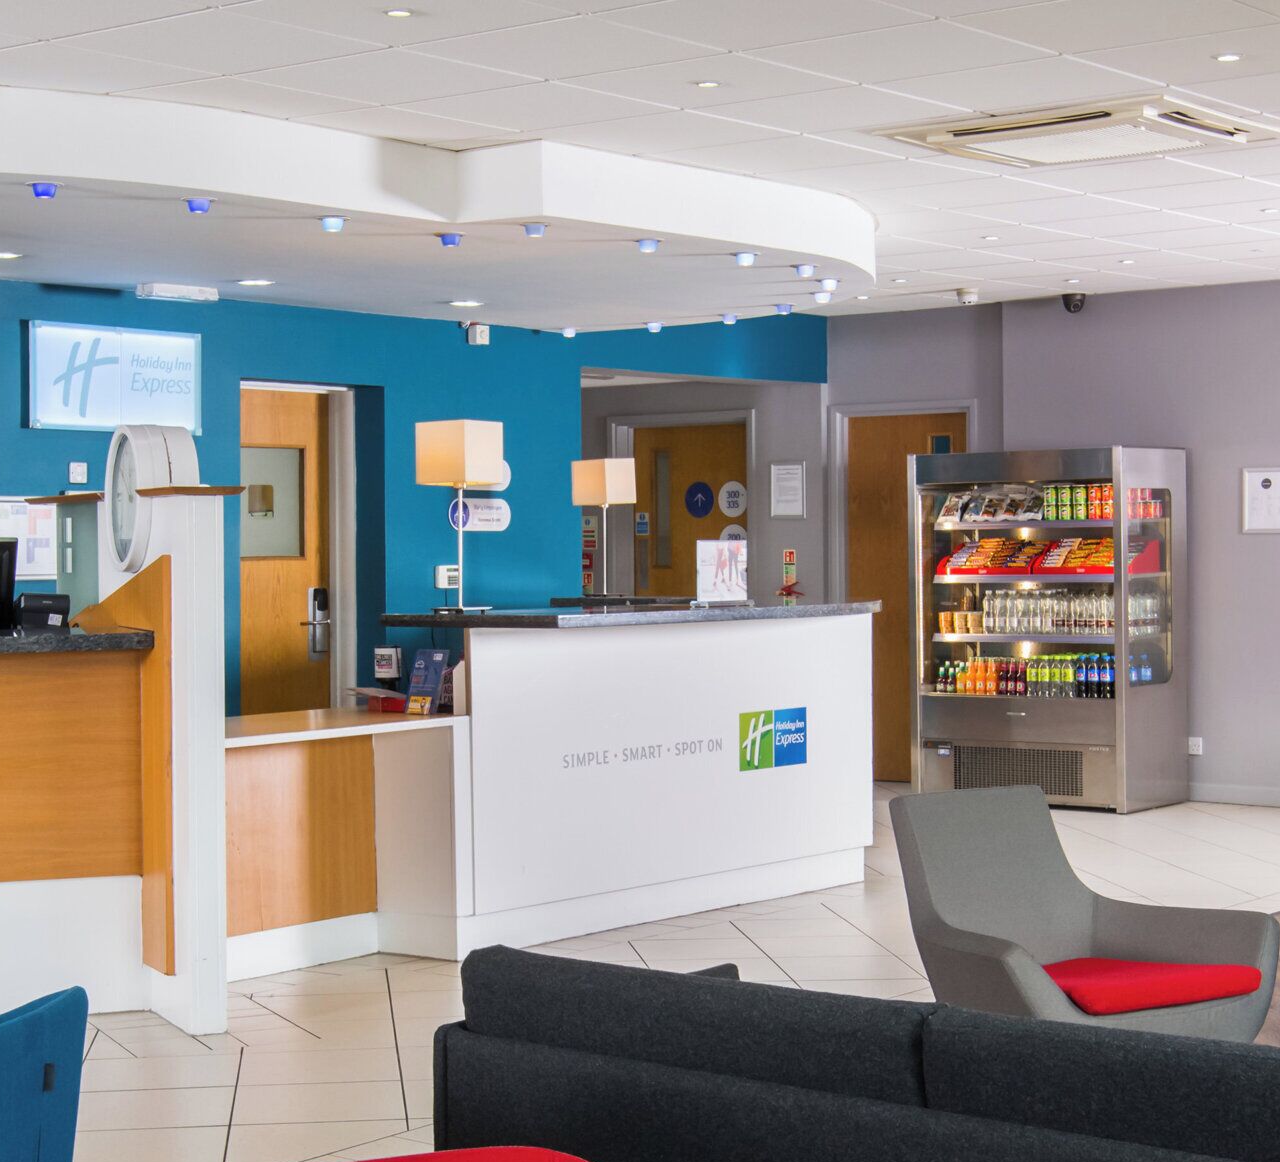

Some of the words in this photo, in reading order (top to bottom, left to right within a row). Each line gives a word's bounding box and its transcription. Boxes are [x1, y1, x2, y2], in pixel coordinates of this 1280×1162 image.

[130, 353, 174, 374] Holiday
[175, 357, 192, 371] Inn
[130, 372, 192, 398] Express
[726, 491, 740, 499] 300
[726, 501, 740, 509] 335
[776, 720, 797, 732] Holiday
[796, 719, 805, 729] Inn
[775, 731, 805, 747] Express
[562, 750, 609, 769] SIMPLE
[622, 744, 662, 763] SMART
[674, 739, 703, 757] SPOT
[707, 737, 723, 752] ON
